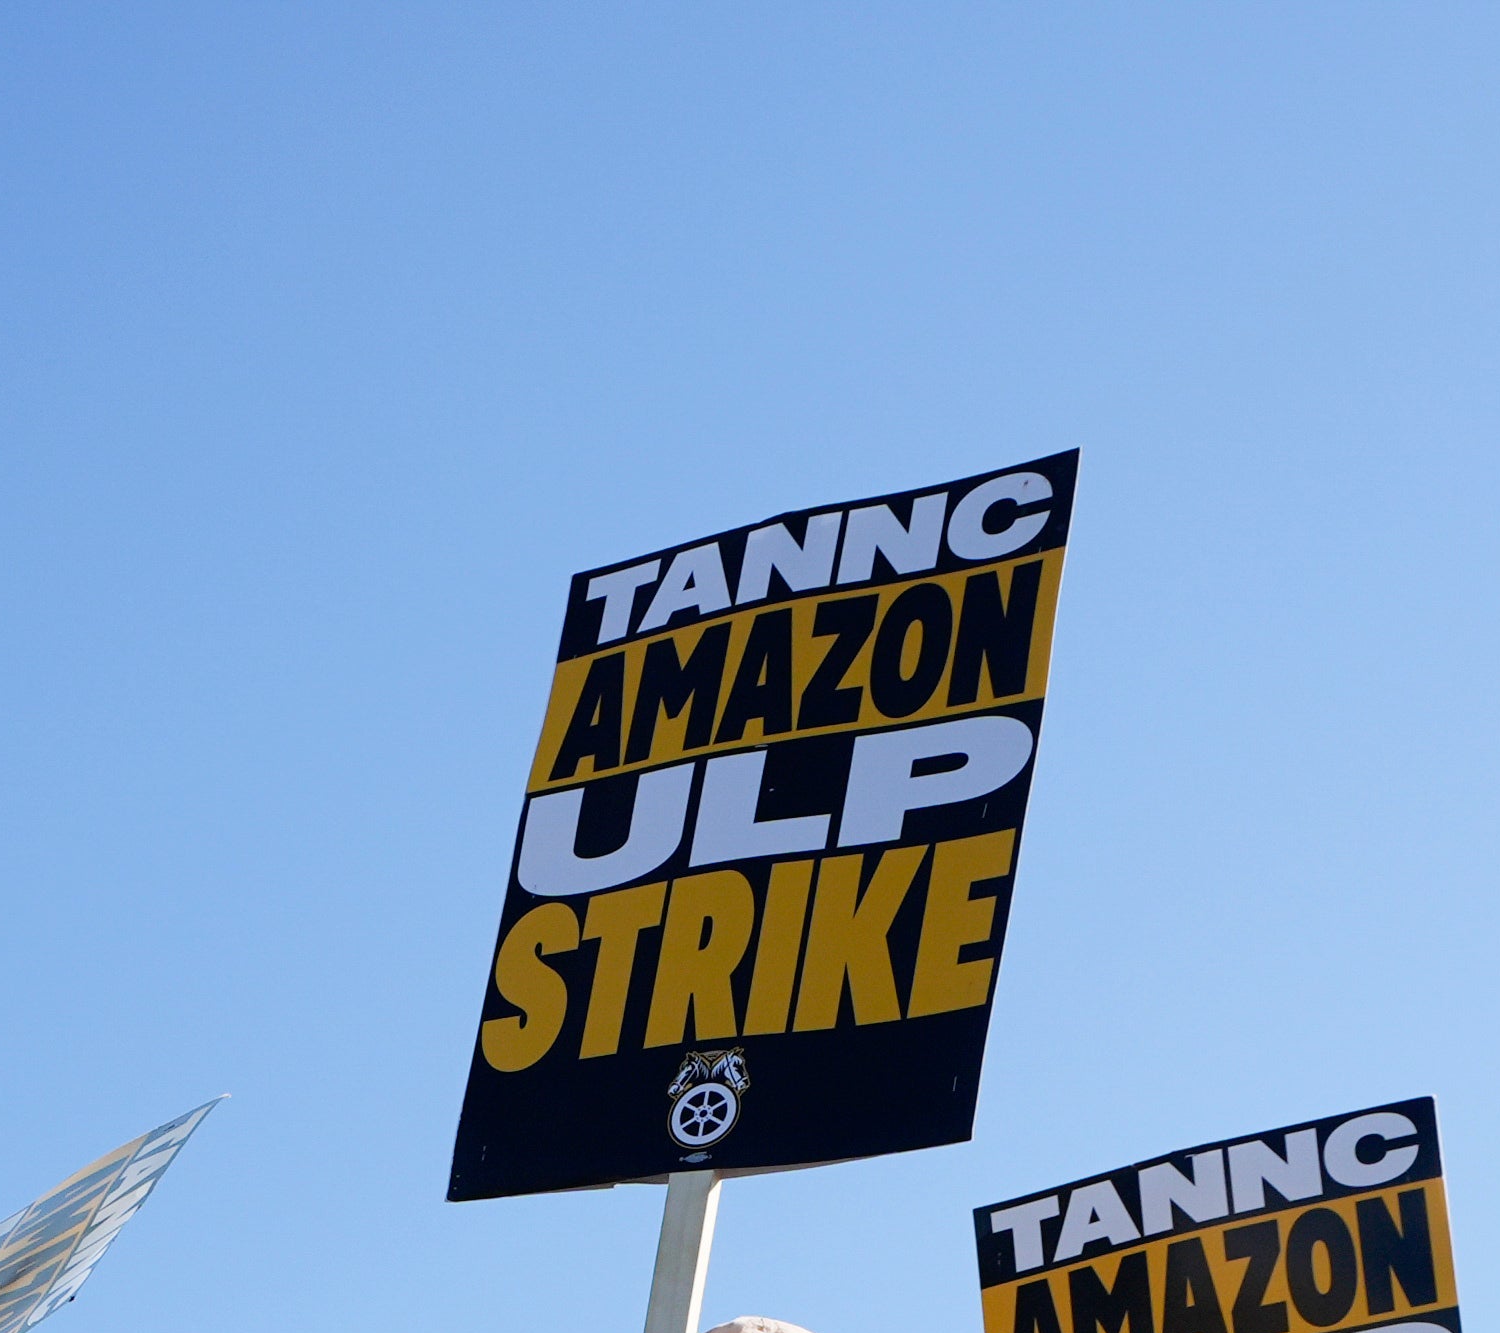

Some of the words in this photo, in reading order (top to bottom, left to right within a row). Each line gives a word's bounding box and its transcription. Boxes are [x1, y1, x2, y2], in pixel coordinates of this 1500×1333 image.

[586, 471, 1054, 646] TANNC
[547, 559, 1044, 782] AMAZON
[517, 715, 1034, 897] ULP
[481, 827, 1016, 1073] STRIKE
[990, 1111, 1420, 1273] TANNC
